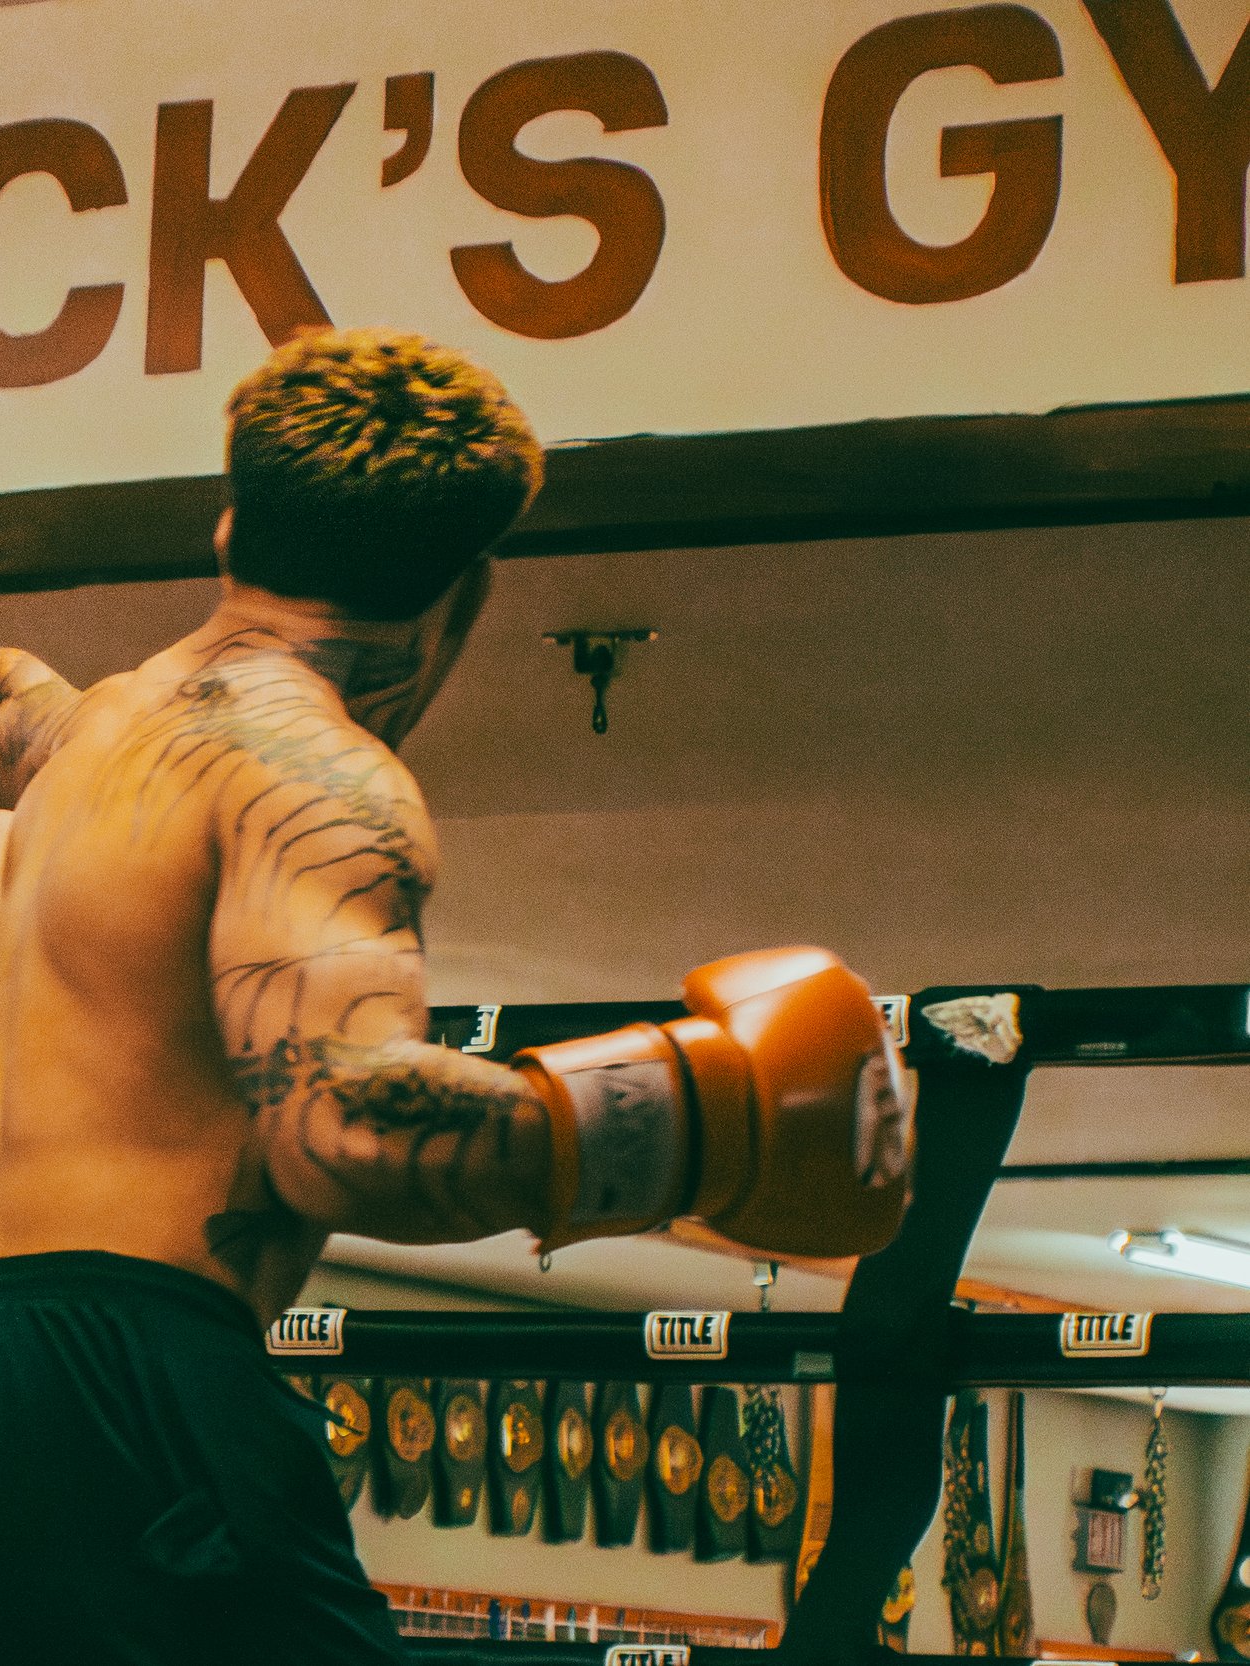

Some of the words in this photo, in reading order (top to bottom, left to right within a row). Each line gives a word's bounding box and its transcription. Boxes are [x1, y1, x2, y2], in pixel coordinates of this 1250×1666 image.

[279, 1313, 330, 1341] TITLE
[658, 1316, 713, 1345] TITLE
[1077, 1314, 1135, 1341] TITLE
